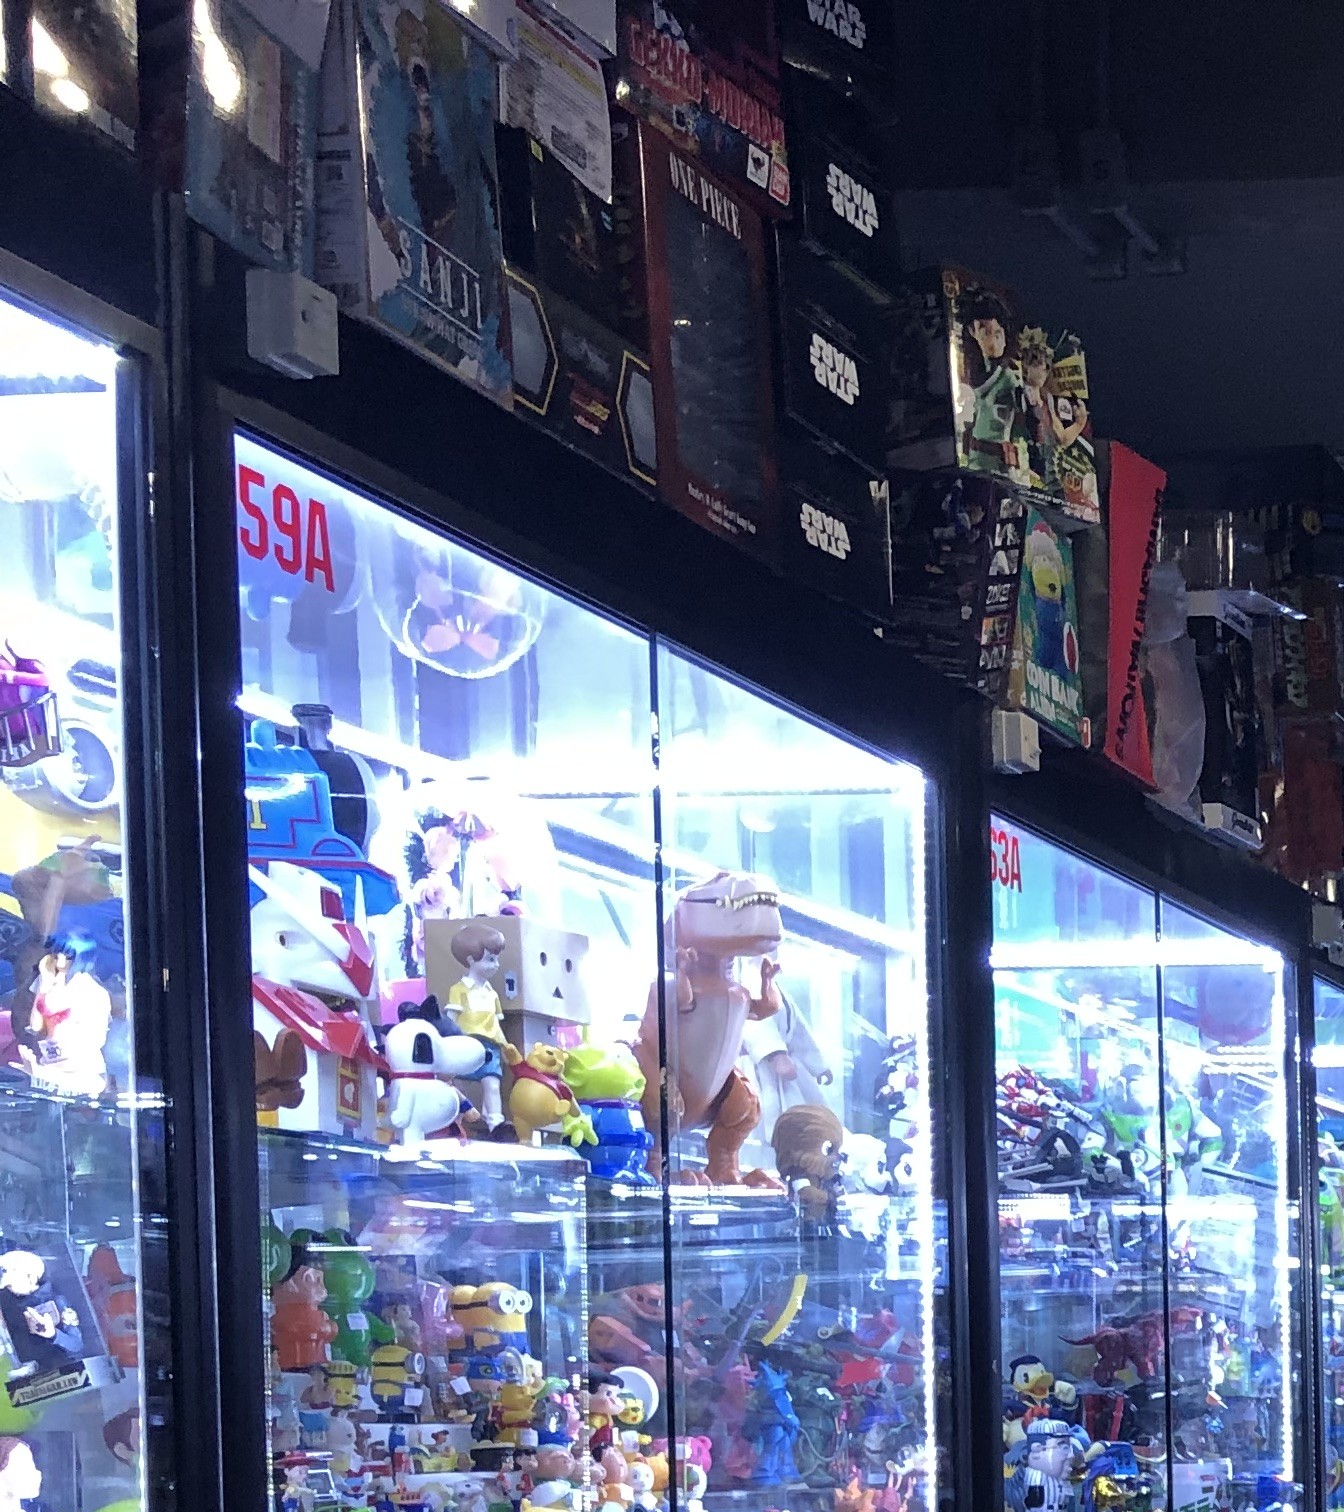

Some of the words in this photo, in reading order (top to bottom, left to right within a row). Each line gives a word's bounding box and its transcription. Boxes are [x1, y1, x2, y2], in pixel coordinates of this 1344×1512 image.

[826, 163, 878, 222] WARS
[827, 185, 879, 238] STAR
[399, 228, 483, 329] SANJI
[809, 333, 859, 391] WARS
[810, 354, 860, 405] STAR
[239, 464, 335, 593] 59A
[800, 503, 850, 545] WARS
[801, 520, 851, 560] STAR
